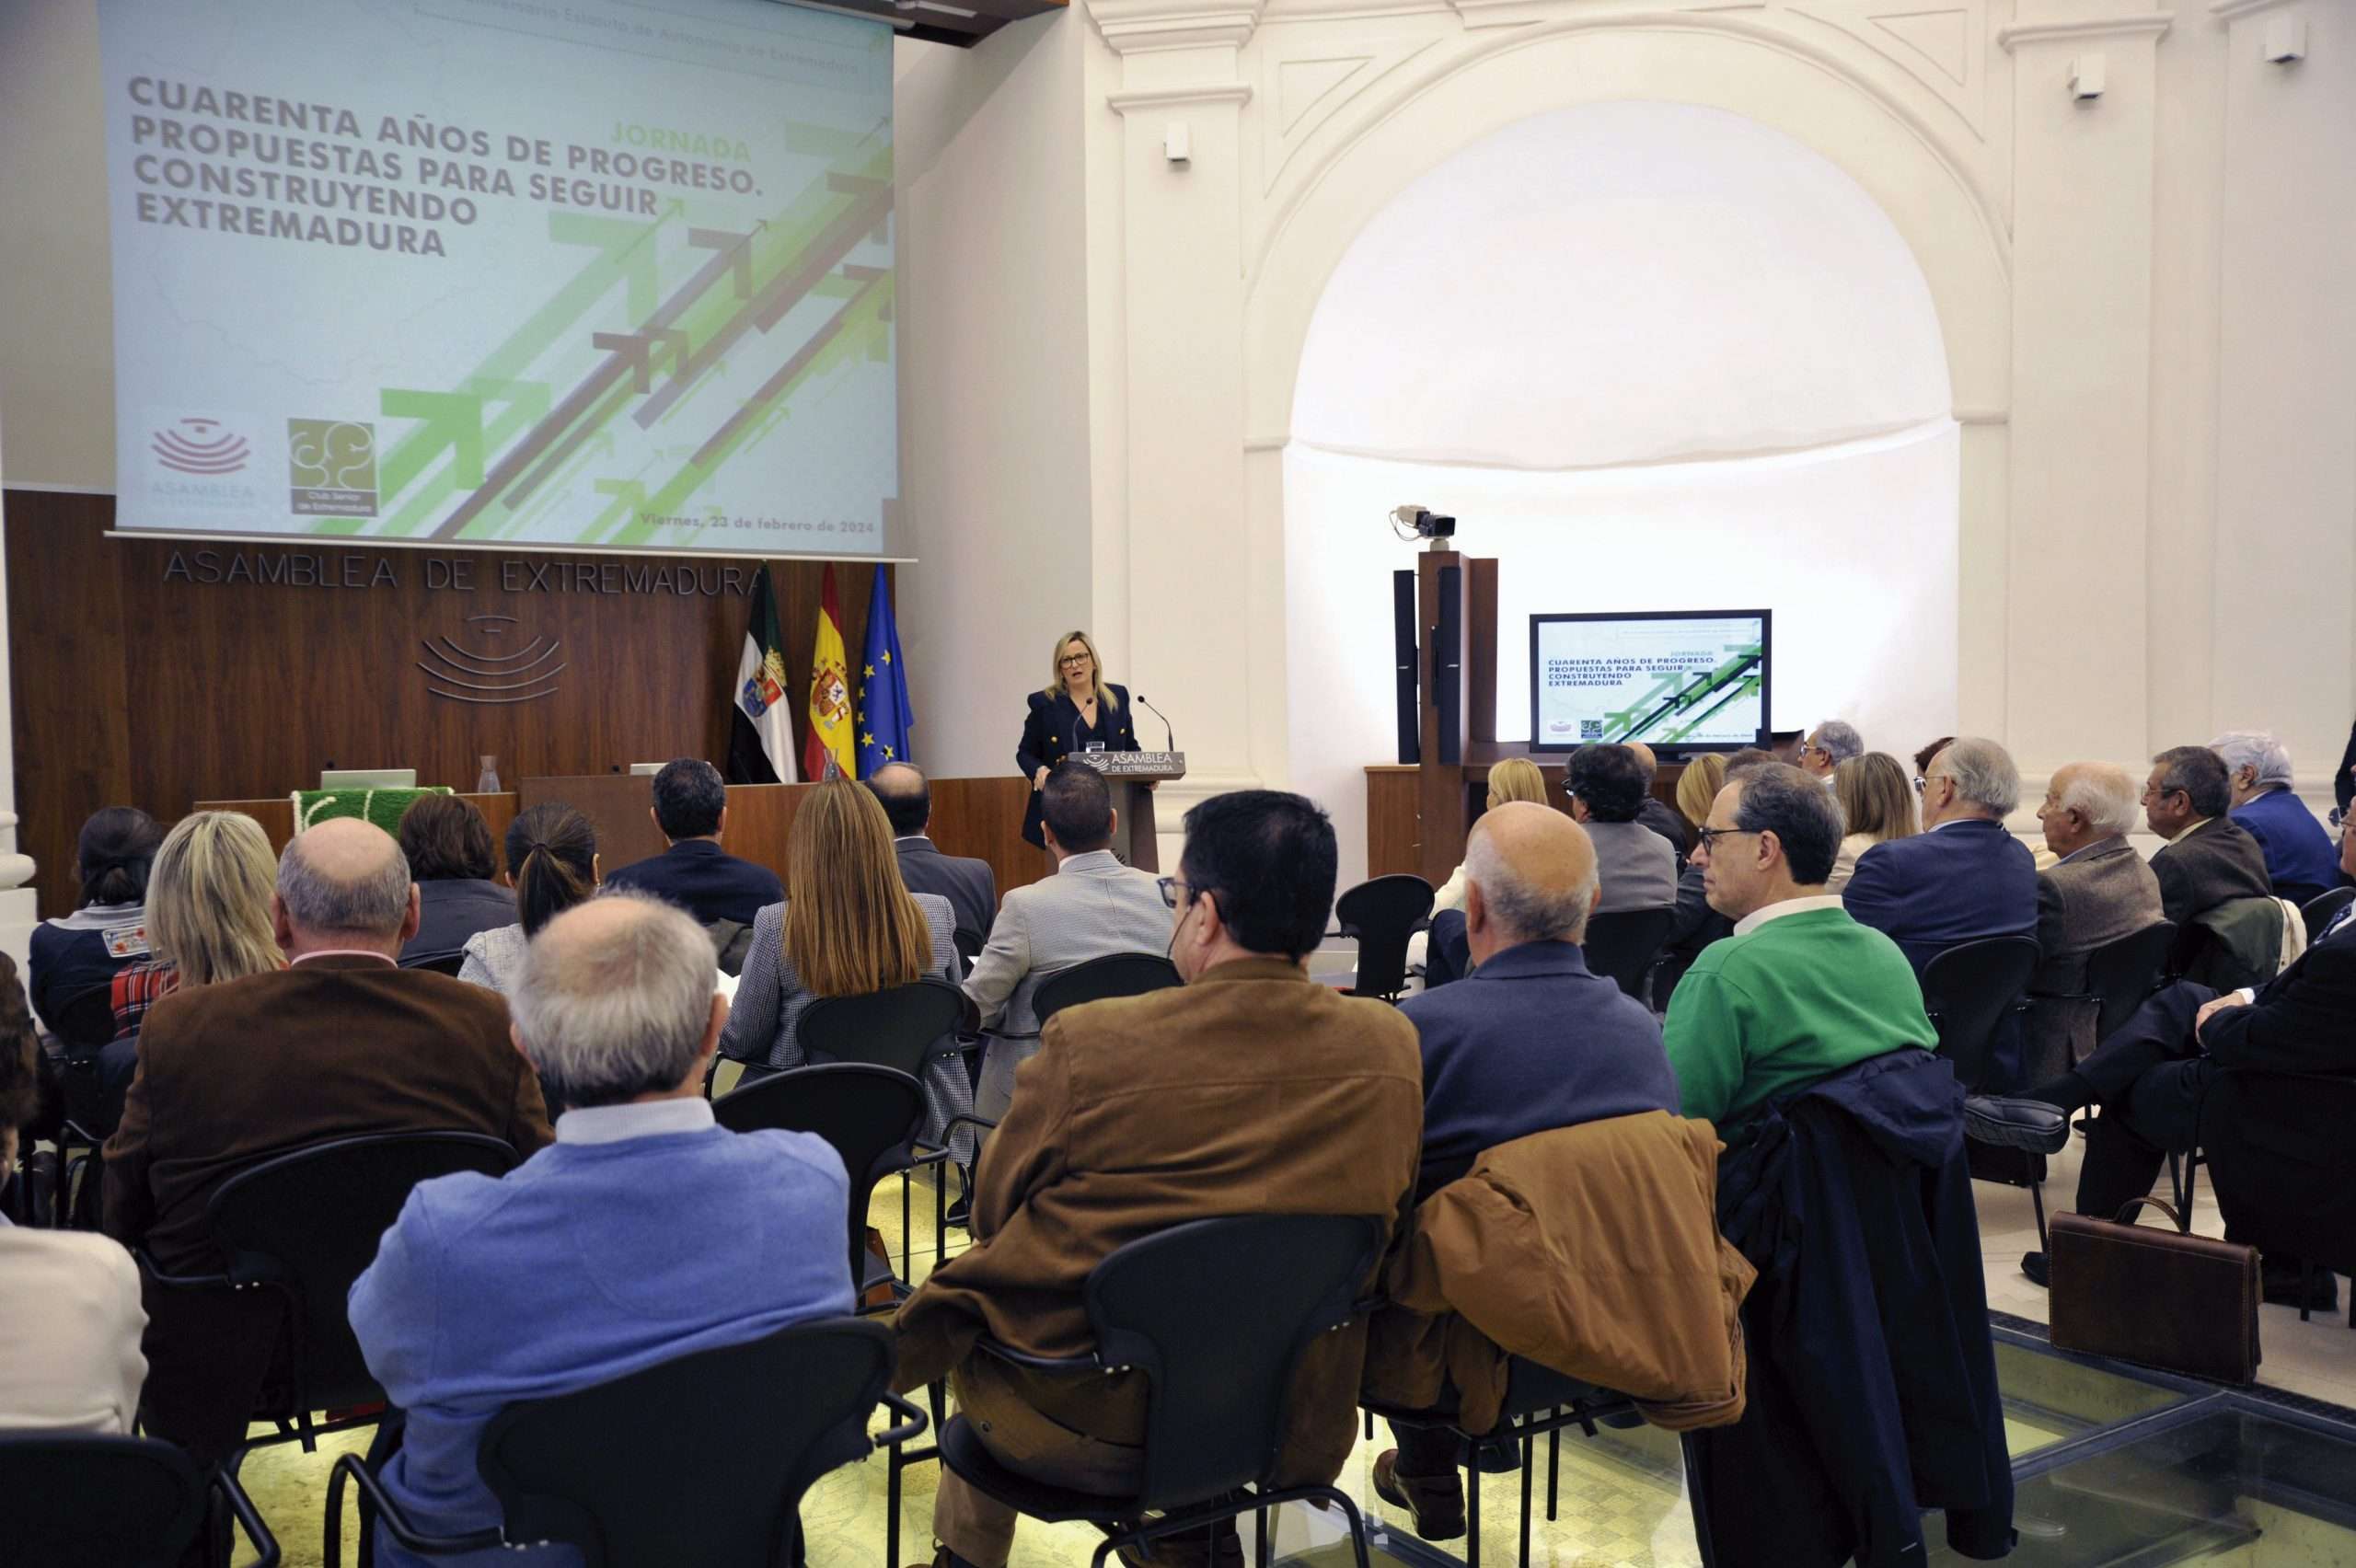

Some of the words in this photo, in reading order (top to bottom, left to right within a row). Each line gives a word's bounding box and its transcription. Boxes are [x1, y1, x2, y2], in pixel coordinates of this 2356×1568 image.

[127, 75, 363, 140] CUARENTA
[376, 112, 491, 158] AÑOS
[506, 134, 552, 167] DE
[566, 144, 764, 198] PROGRESO.
[611, 121, 752, 163] JORNADA
[131, 113, 403, 182] PROPUESTAS
[418, 156, 516, 198] PARA
[528, 172, 658, 217] SEGUIR
[133, 153, 477, 226] CONSTRUYENDO
[136, 190, 446, 258] EXTREMADURA
[640, 513, 706, 528] Viernes,
[733, 515, 752, 530] de
[757, 515, 813, 532] febrero
[816, 519, 835, 532] de
[839, 520, 875, 534] 2024
[163, 549, 398, 589] ASAMBLEA
[425, 558, 475, 590] DE
[1548, 658, 1602, 666] CUARENTA
[1640, 657, 1654, 665] DE
[1616, 664, 1643, 673] PARA
[1548, 672, 1633, 680] CONSTRUYENDO
[1548, 679, 1623, 687] EXTREMADURA
[1111, 753, 1172, 765] ASAMBLEA
[1111, 765, 1122, 773] DE
[1122, 765, 1174, 773] EXTREMADURA
